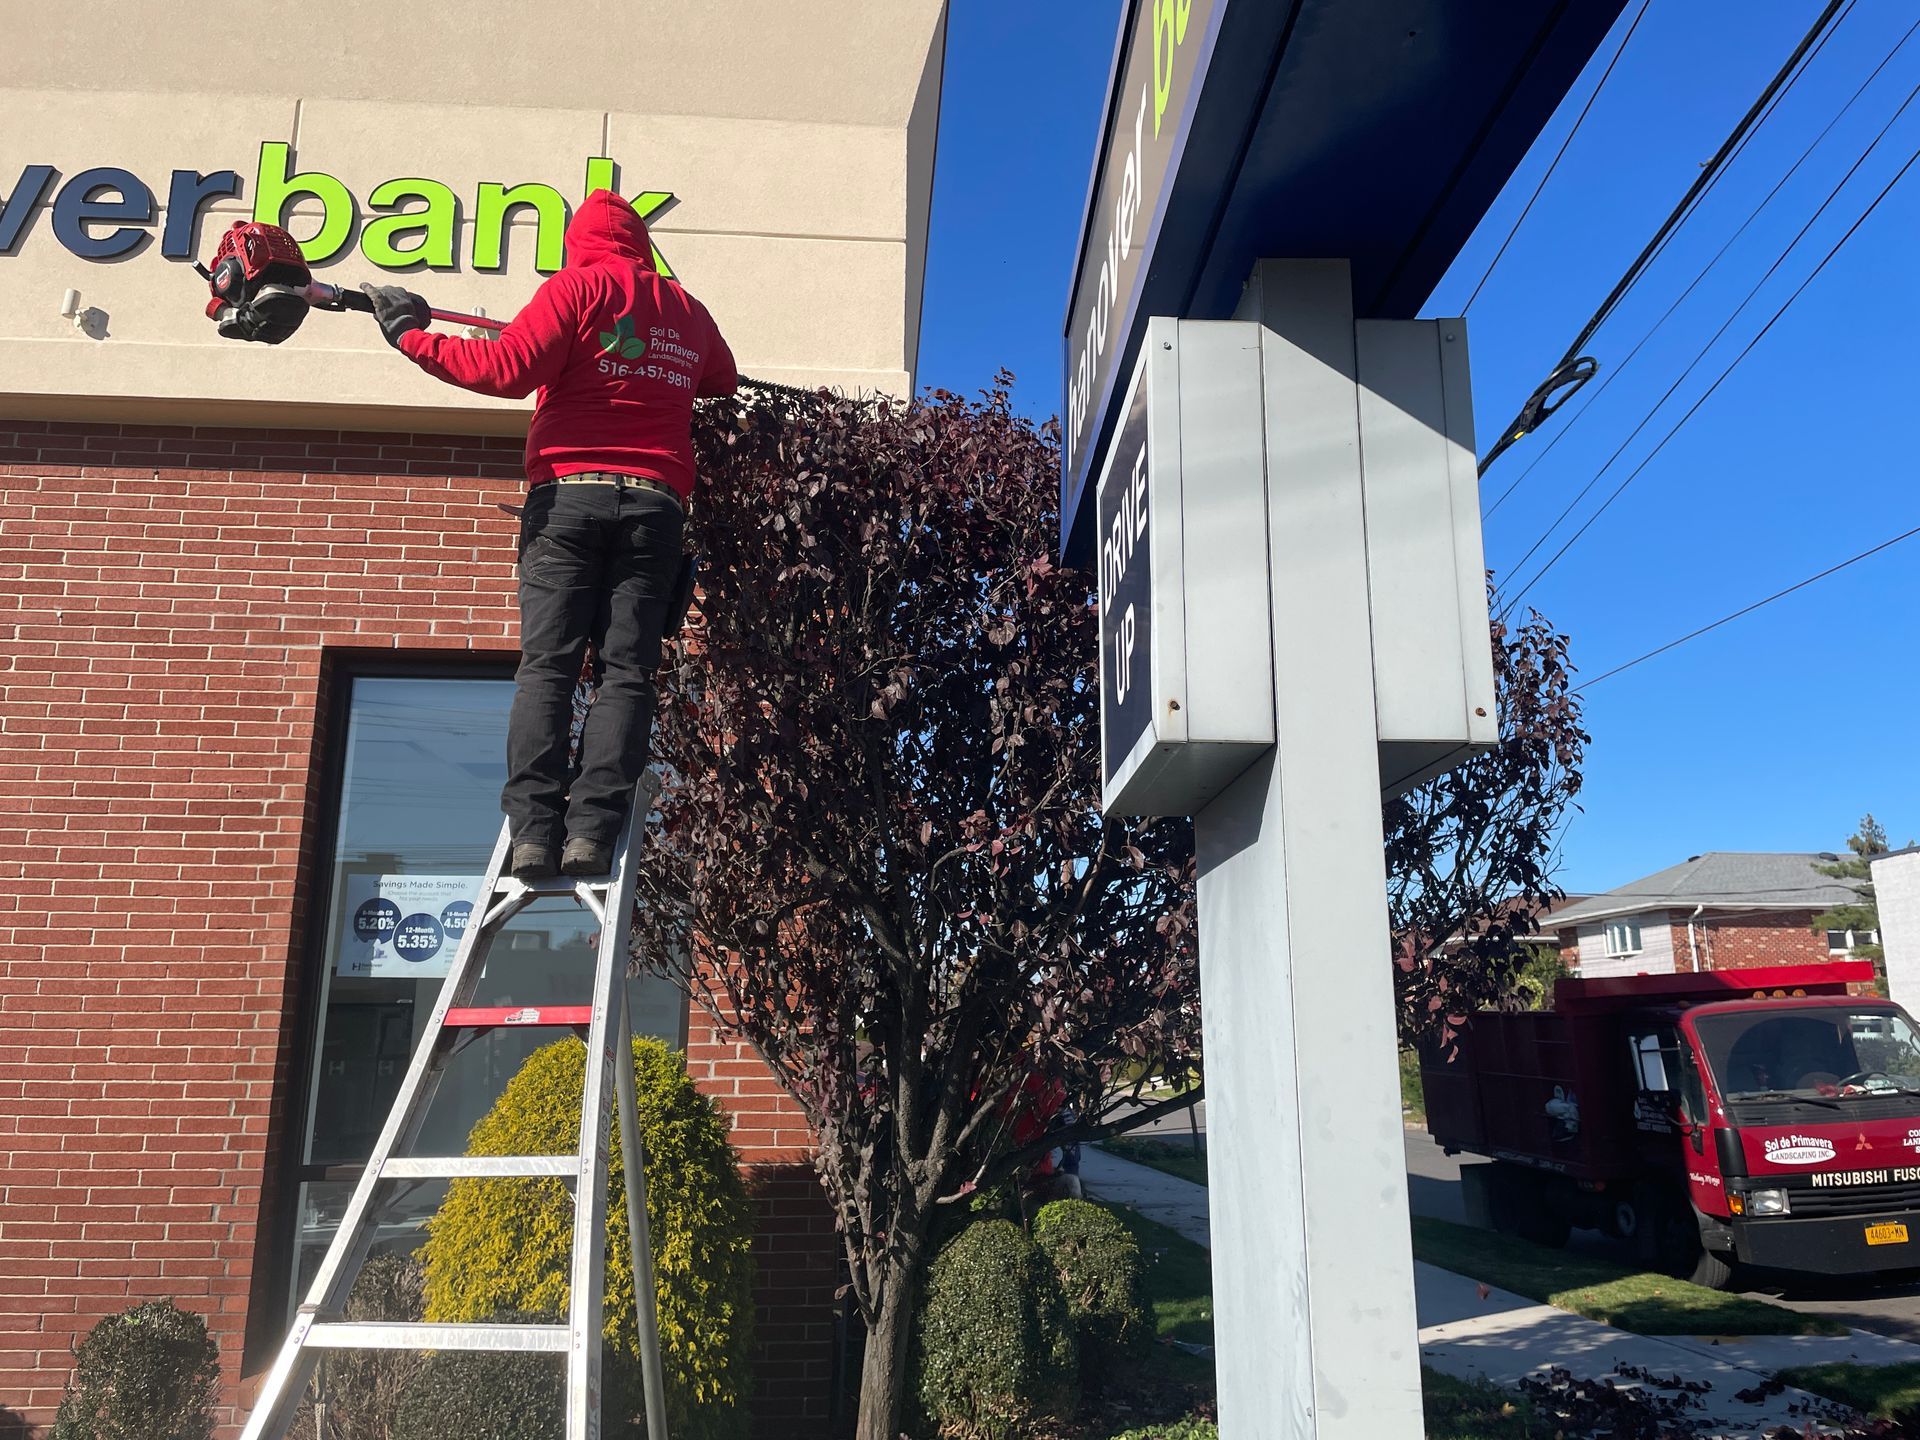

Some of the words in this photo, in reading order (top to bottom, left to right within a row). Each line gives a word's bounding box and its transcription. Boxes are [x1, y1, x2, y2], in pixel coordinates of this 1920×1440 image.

[1068, 82, 1147, 472] hanover
[650, 326, 665, 338] Sol
[668, 328, 680, 341] De
[651, 337, 700, 364] Primavera
[598, 359, 692, 390] 516-457-9811
[1103, 441, 1147, 617] DRIVE
[1115, 602, 1135, 706] UP
[373, 881, 407, 889] Savings
[409, 881, 434, 889] Made
[436, 881, 468, 889] Simple.
[358, 917, 395, 930] 5.20%
[405, 926, 435, 934] 12-Month
[397, 934, 438, 949] 5.35%
[1764, 1138, 1780, 1152] Sol
[1779, 1136, 1791, 1149] de
[1790, 1134, 1834, 1149] Primavera
[1771, 1151, 1817, 1160] LANDSCAPING
[1818, 1150, 1832, 1158] INC.
[1811, 1169, 1888, 1187] MITSUBISHI
